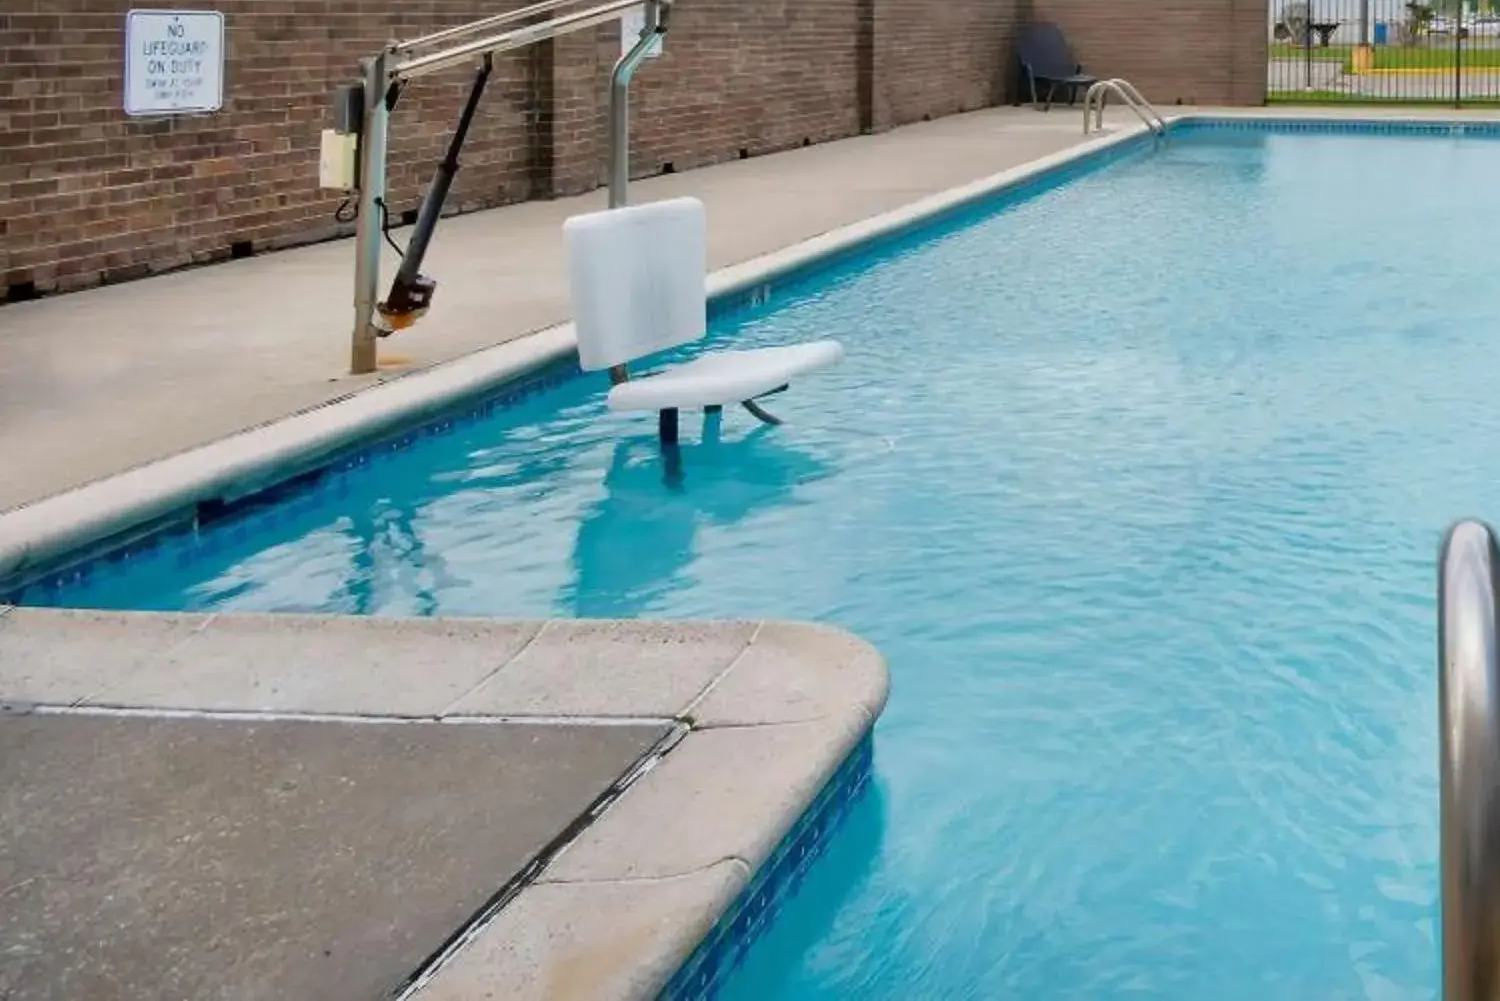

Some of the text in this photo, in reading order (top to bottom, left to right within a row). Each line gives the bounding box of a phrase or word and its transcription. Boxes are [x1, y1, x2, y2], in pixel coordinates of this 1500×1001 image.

[167, 24, 185, 38] NO
[147, 59, 202, 74] ON DUTY
